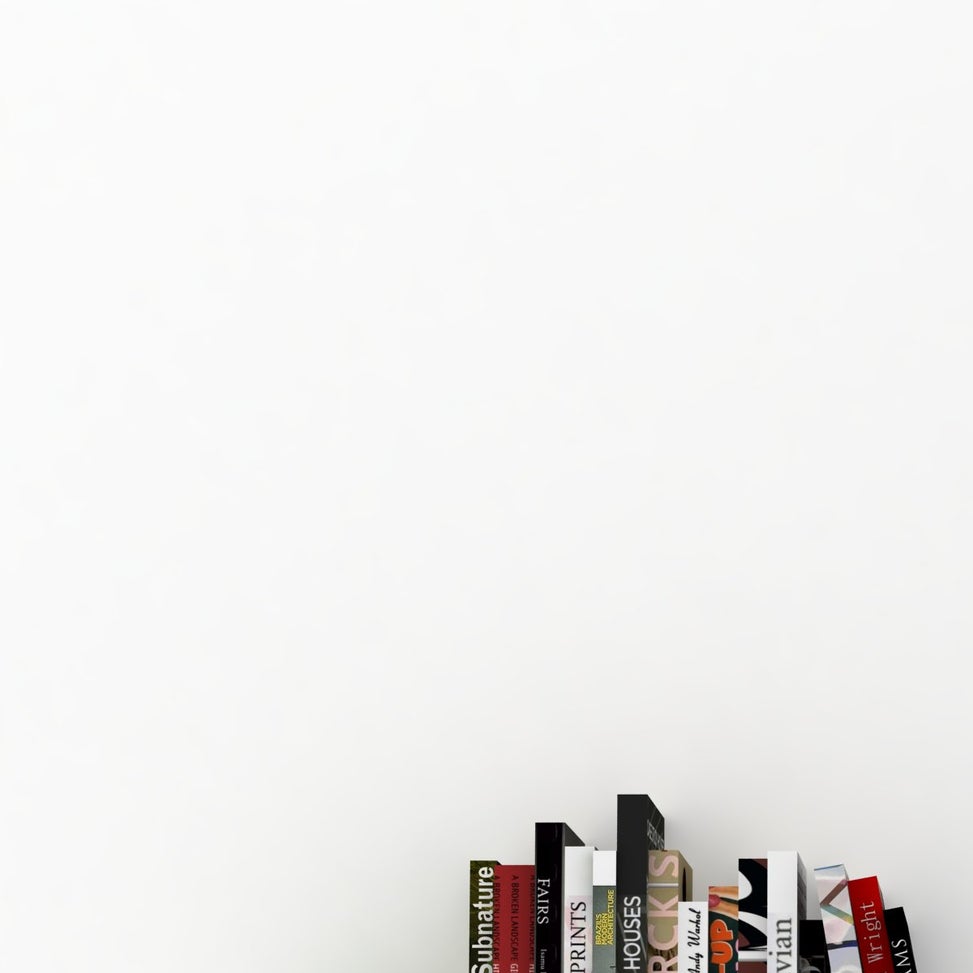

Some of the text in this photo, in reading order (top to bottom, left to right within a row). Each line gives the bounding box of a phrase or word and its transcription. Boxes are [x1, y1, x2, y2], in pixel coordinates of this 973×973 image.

[511, 882, 519, 913] BROKEN
[537, 879, 550, 925] FAIRS
[511, 915, 519, 961] LANDSCAPE
[570, 901, 587, 969] PRINTS
[623, 895, 641, 970] HOUSES
[687, 907, 702, 947] Warhol
[860, 900, 885, 964] Wright
